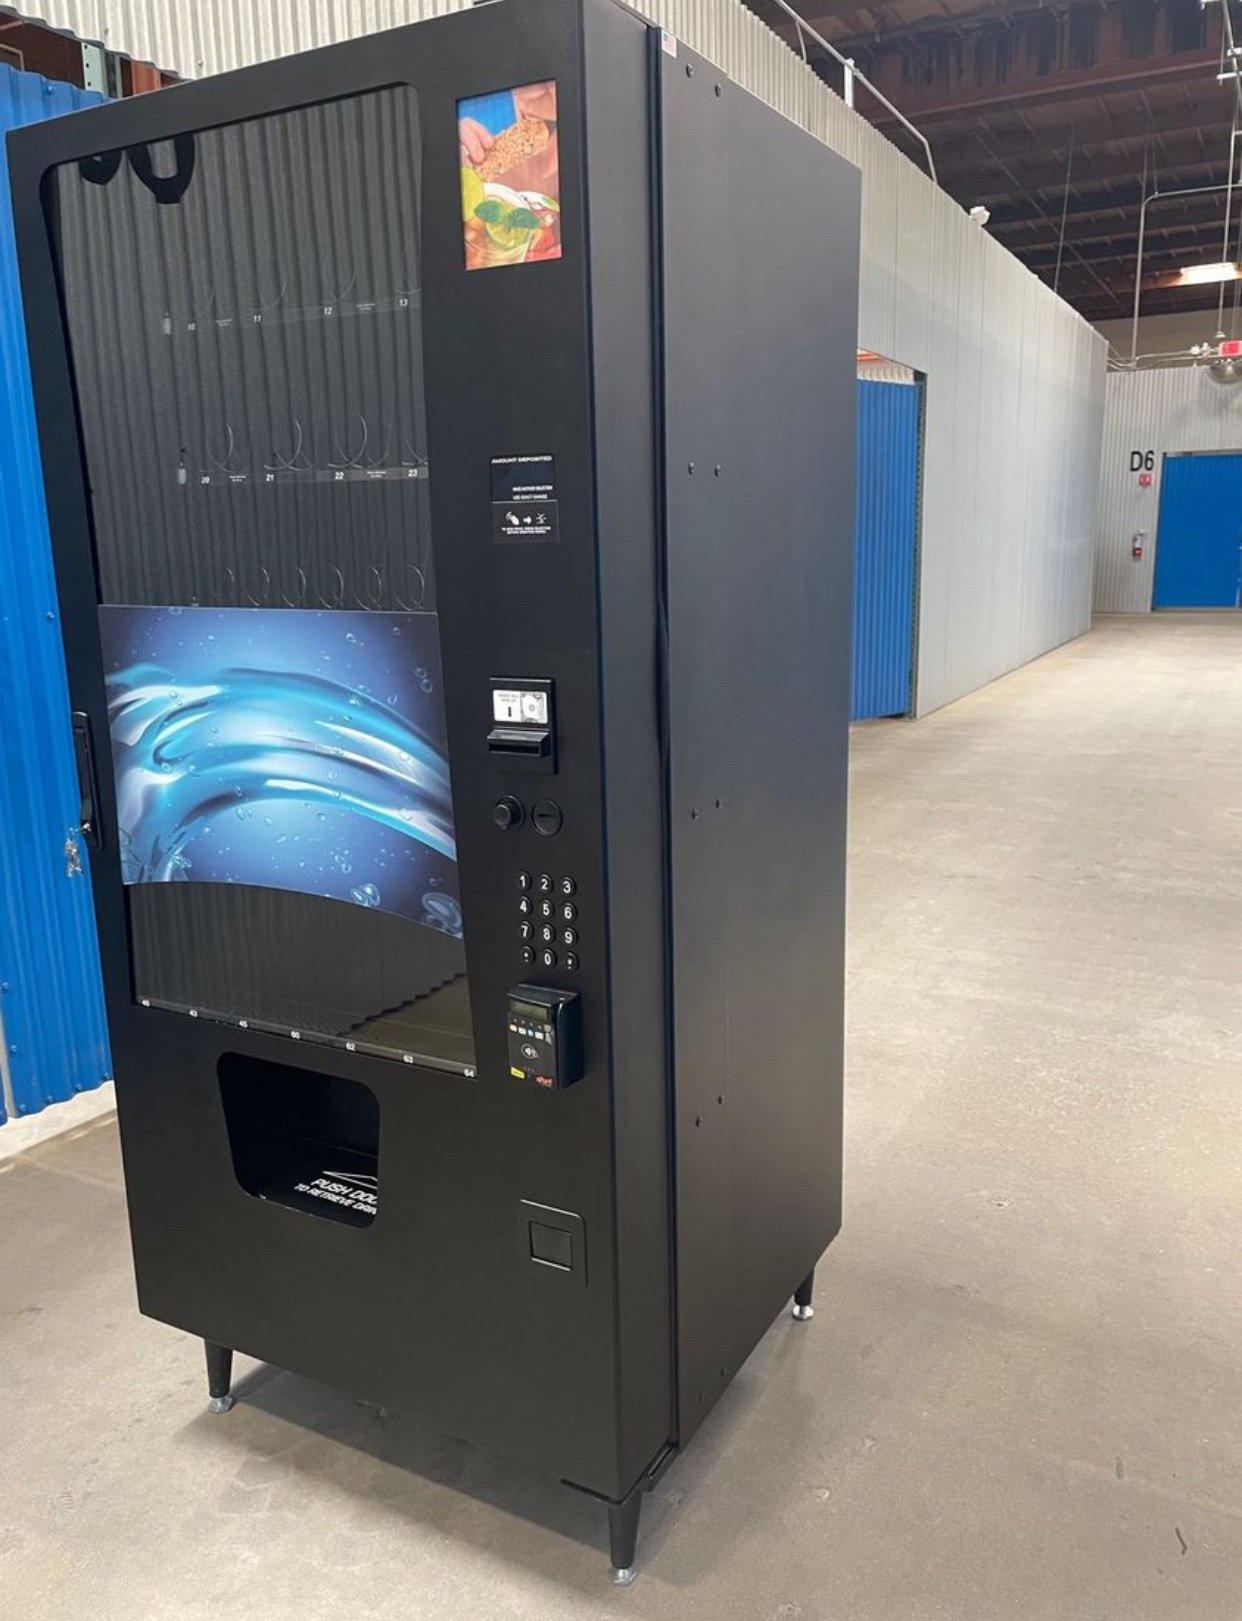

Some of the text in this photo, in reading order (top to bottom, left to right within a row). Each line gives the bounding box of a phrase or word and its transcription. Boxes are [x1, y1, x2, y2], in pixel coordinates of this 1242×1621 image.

[324, 306, 333, 315] 12
[1130, 451, 1154, 471] D6
[334, 472, 344, 480] 22
[408, 469, 417, 477] 23
[519, 874, 571, 893] 1 2 3
[519, 900, 572, 919] 4 5 6
[521, 925, 573, 944] 7 8 9
[544, 953, 551, 965] 0
[403, 1055, 413, 1063] 63
[464, 1068, 474, 1078] 64
[294, 1183, 310, 1191] TO
[307, 1188, 356, 1206] RETRIEVE
[310, 1178, 353, 1195] PUSH
